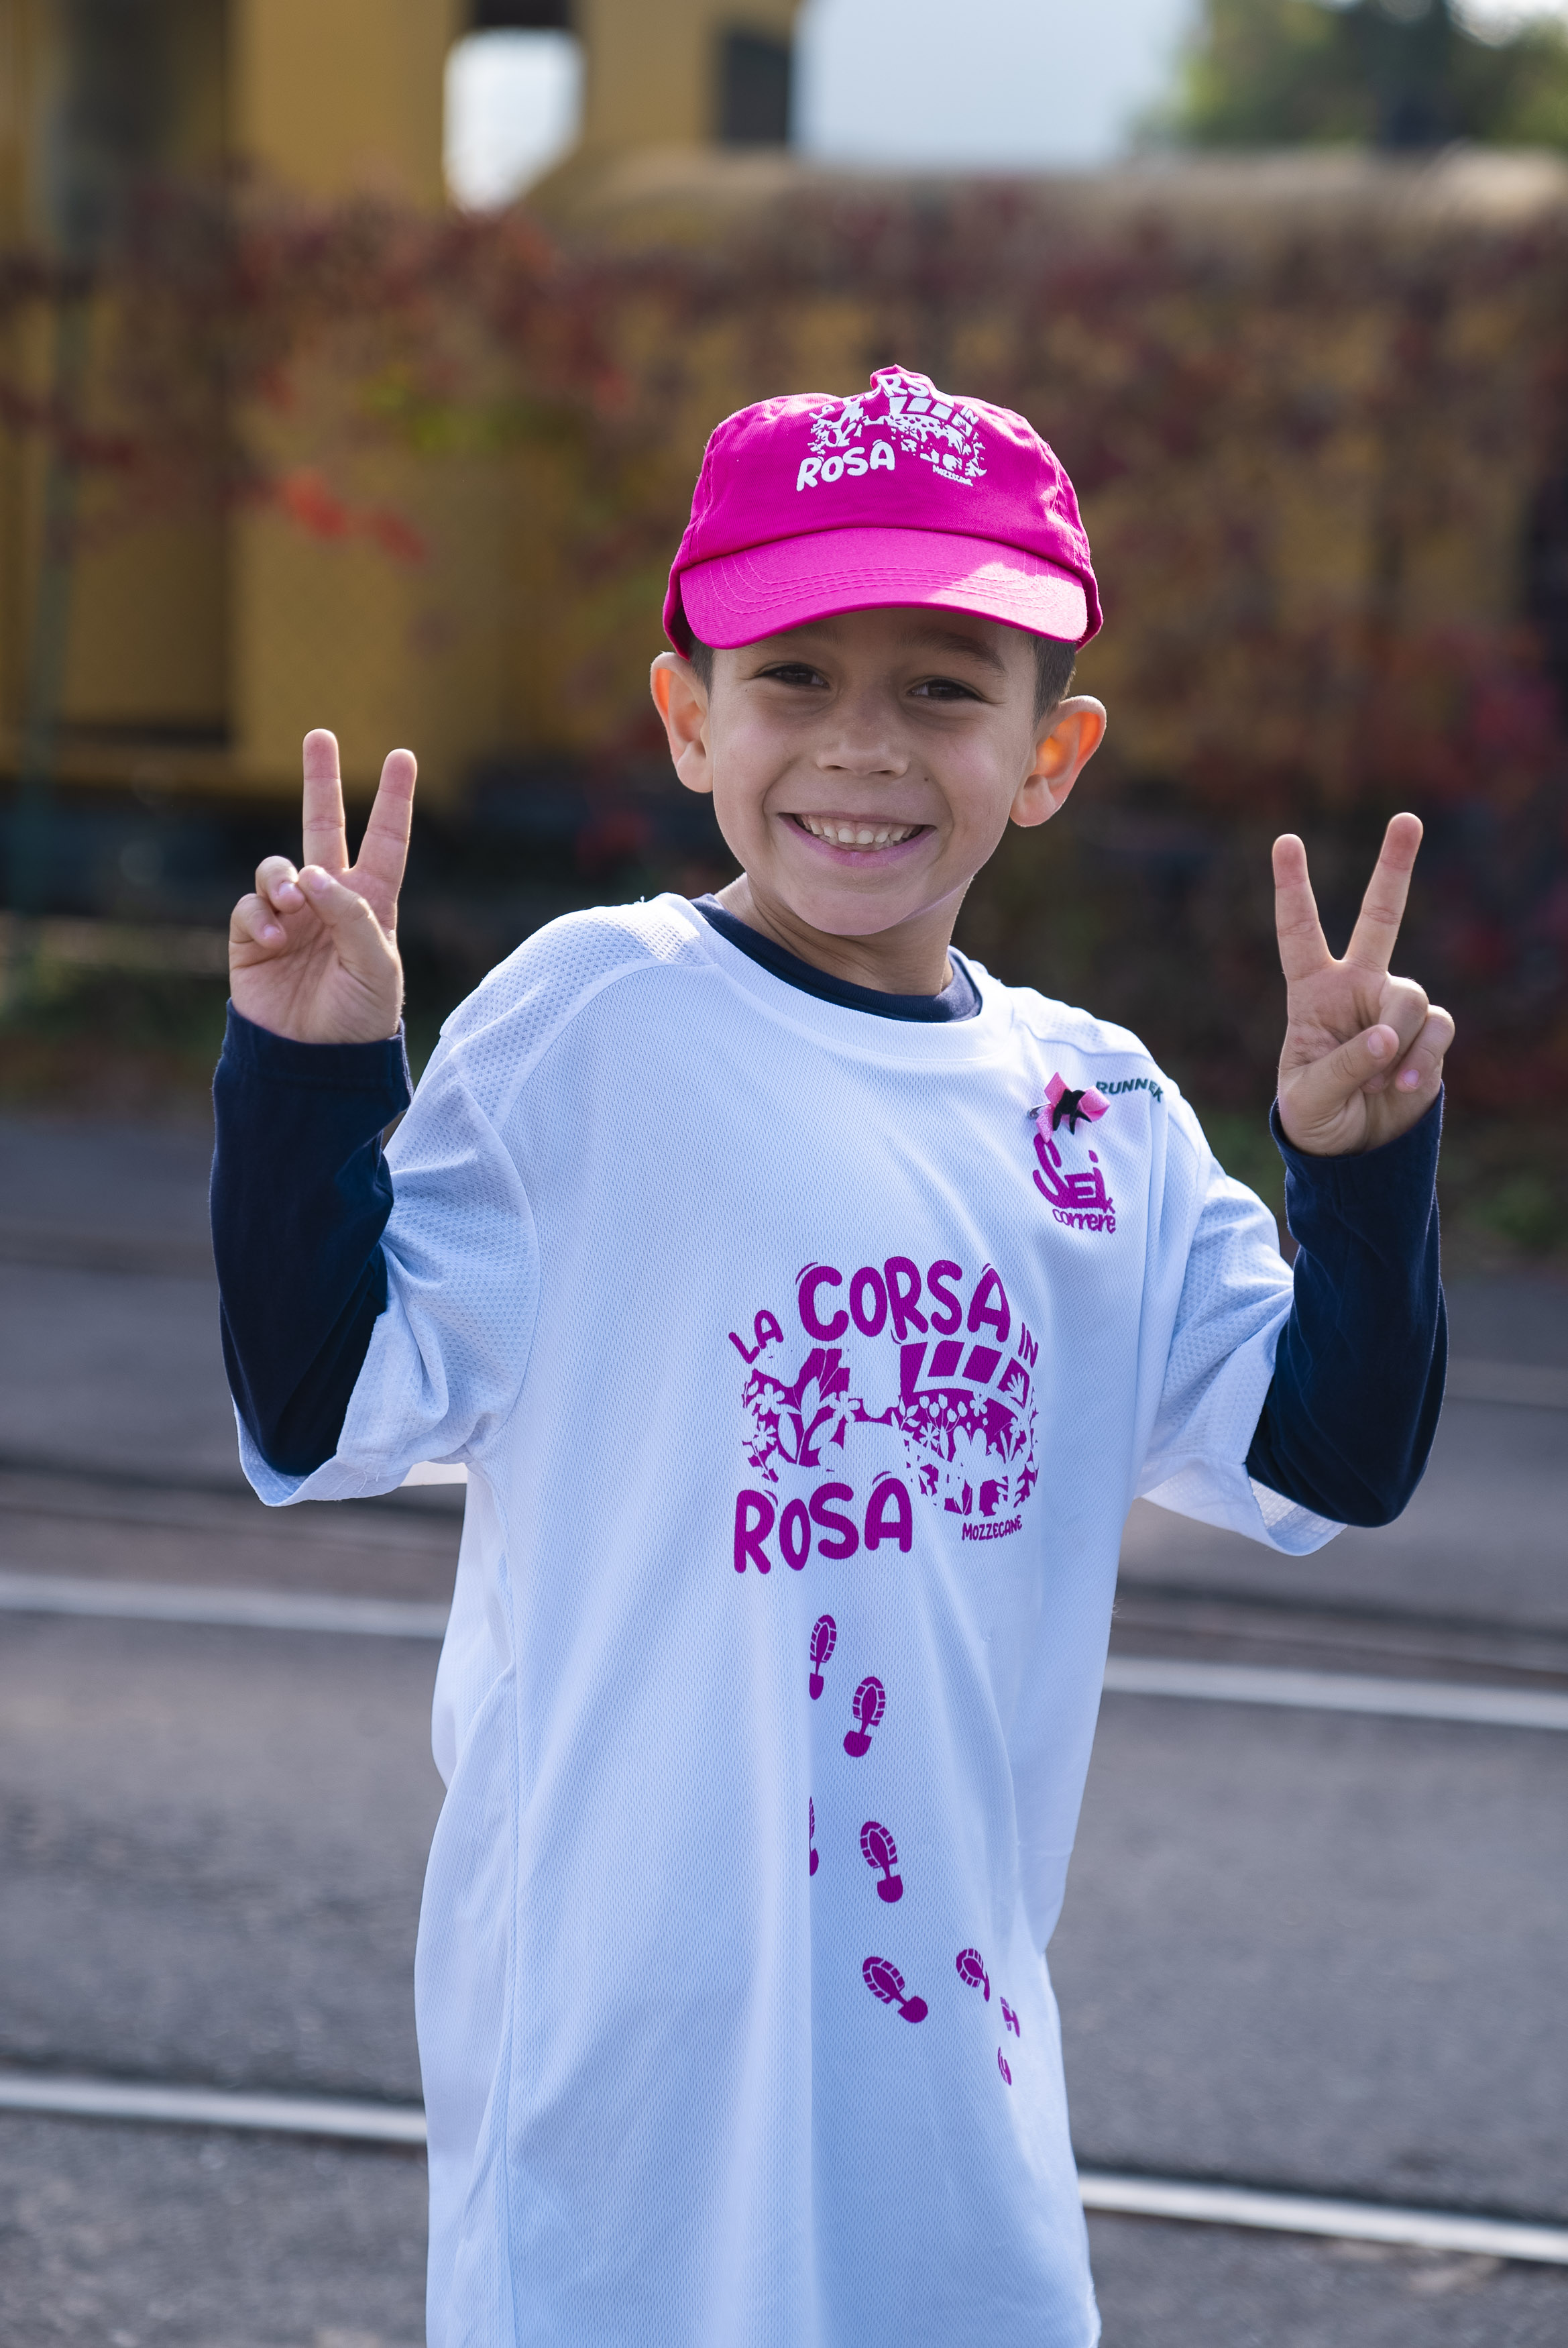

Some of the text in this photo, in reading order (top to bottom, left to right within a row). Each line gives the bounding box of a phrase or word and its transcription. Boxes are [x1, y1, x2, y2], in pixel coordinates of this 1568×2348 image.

[796, 441, 895, 492] ROSA
[1052, 1209, 1116, 1234] correre
[728, 1256, 1039, 1368] LA CORSA IN
[734, 1478, 913, 1574] ROSA
[962, 1515, 1023, 1541] MOZZECANE
